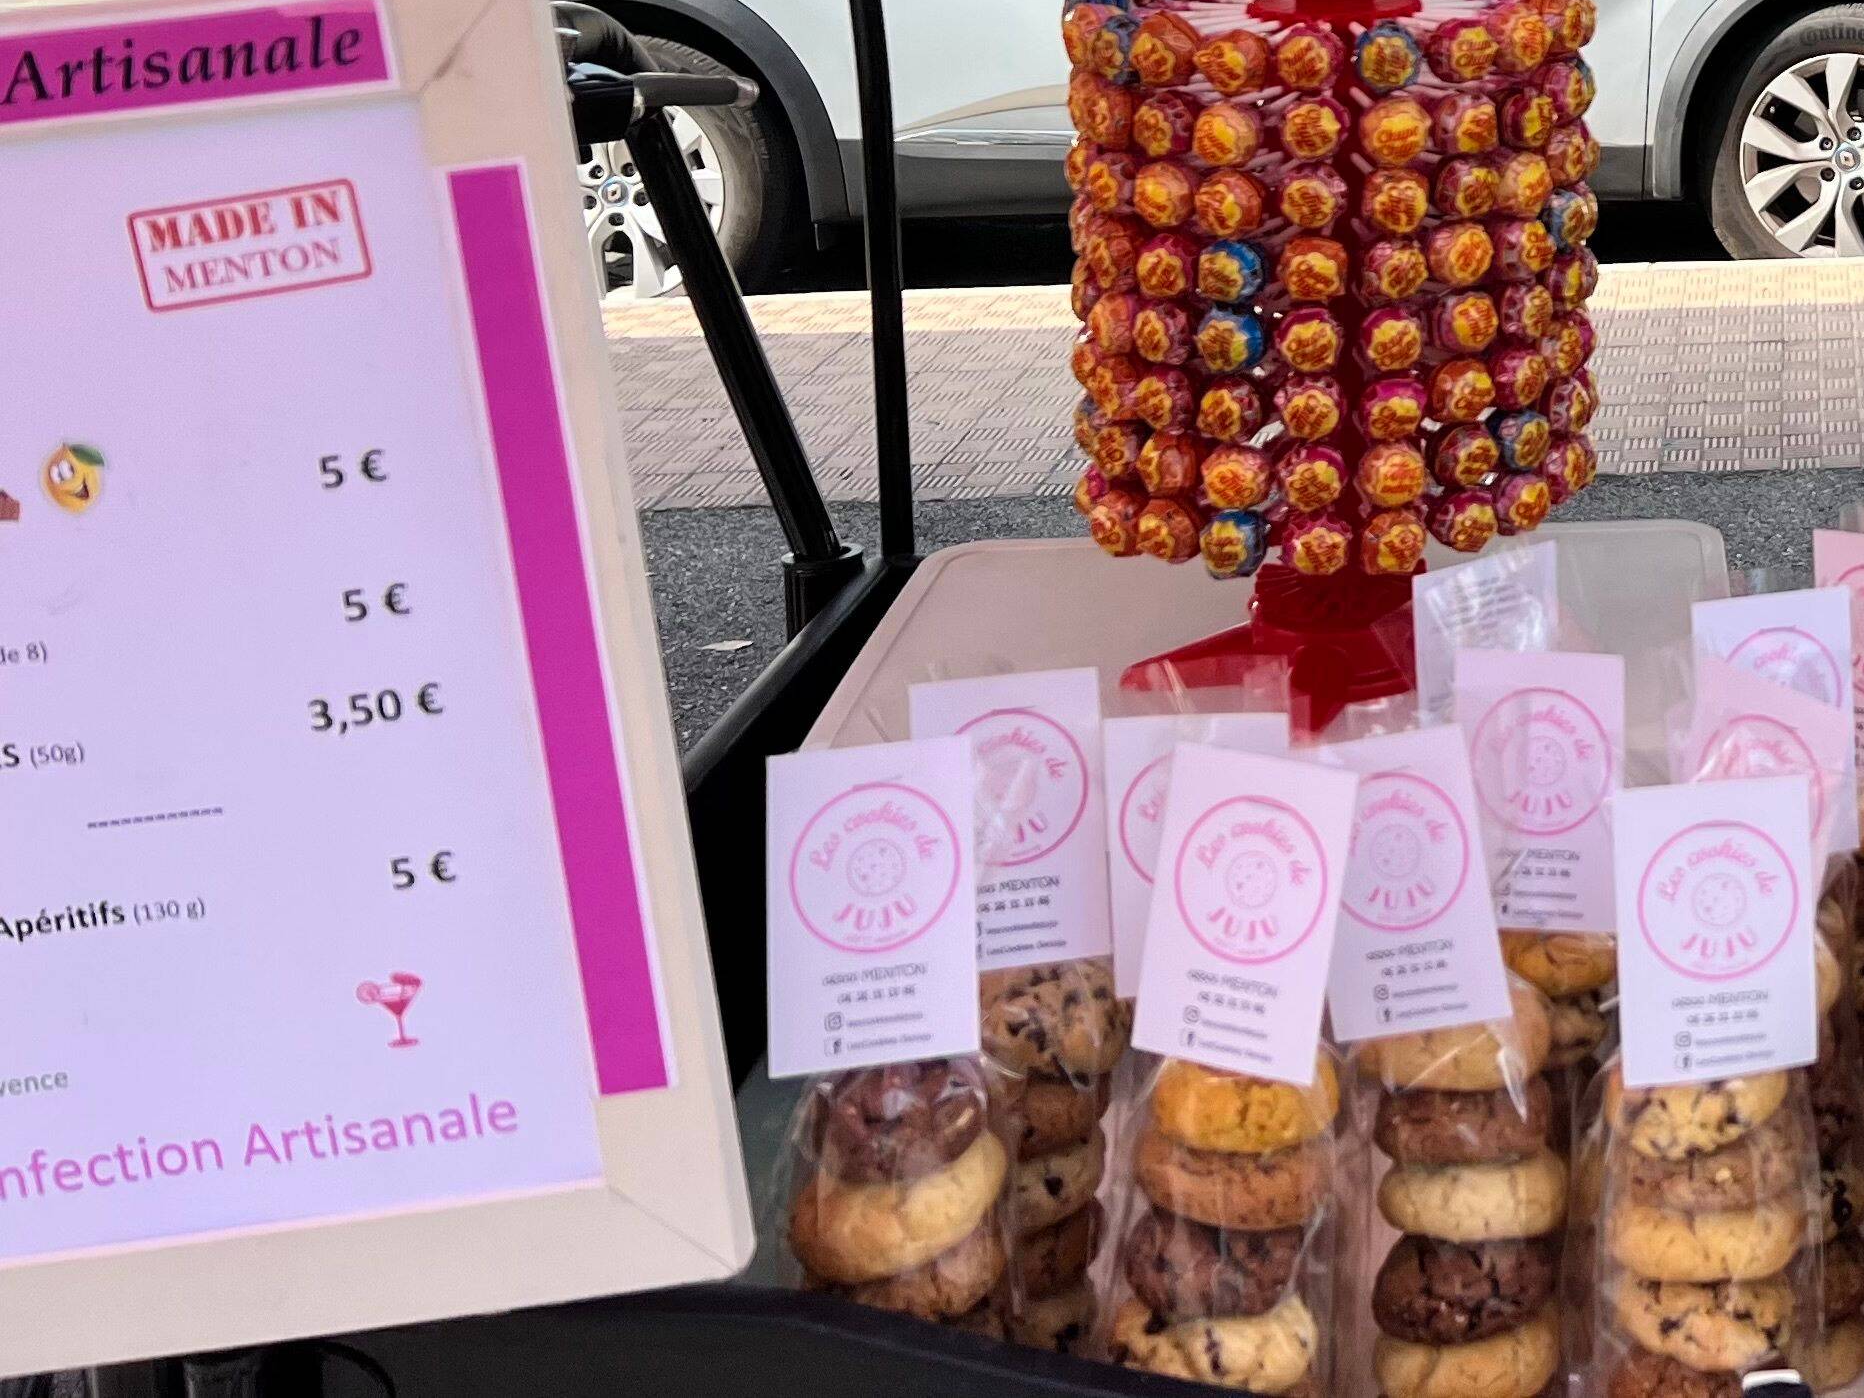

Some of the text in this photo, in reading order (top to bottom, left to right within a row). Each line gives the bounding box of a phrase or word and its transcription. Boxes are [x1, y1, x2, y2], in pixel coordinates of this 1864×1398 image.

[3, 14, 363, 103] Artisanale
[146, 190, 344, 254] MADE IN
[161, 238, 344, 296] MENTON
[319, 448, 388, 490] 5 €
[343, 582, 411, 623] 5 €
[26, 640, 48, 664] 8)
[307, 682, 445, 736] 3,50 €
[30, 742, 85, 770] (50g)
[390, 850, 458, 892] 5 €
[1366, 874, 1435, 910] JUJU
[0, 898, 206, 942] Apéritifs (130 g)
[832, 892, 917, 931] JUJU
[1207, 906, 1279, 942] JUJU
[1681, 924, 1758, 959] JUJU
[243, 1092, 521, 1168] Artisanale
